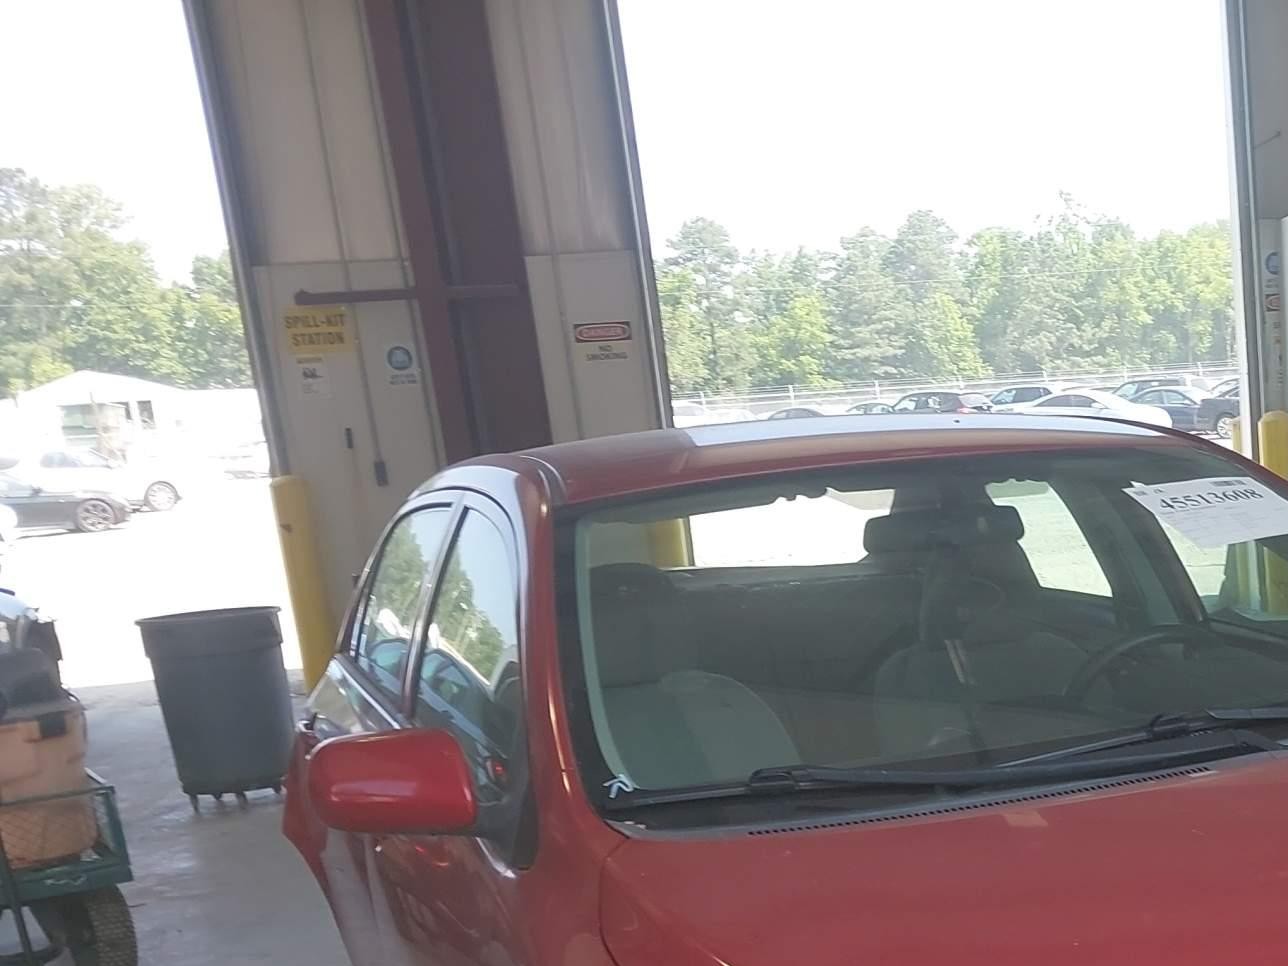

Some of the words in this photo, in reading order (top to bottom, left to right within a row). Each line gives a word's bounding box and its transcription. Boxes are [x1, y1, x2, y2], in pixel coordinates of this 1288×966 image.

[284, 313, 345, 329] SPILL-KIT
[292, 331, 345, 346] STATION
[582, 326, 624, 337] DANGER
[1159, 487, 1265, 511] 45513608
